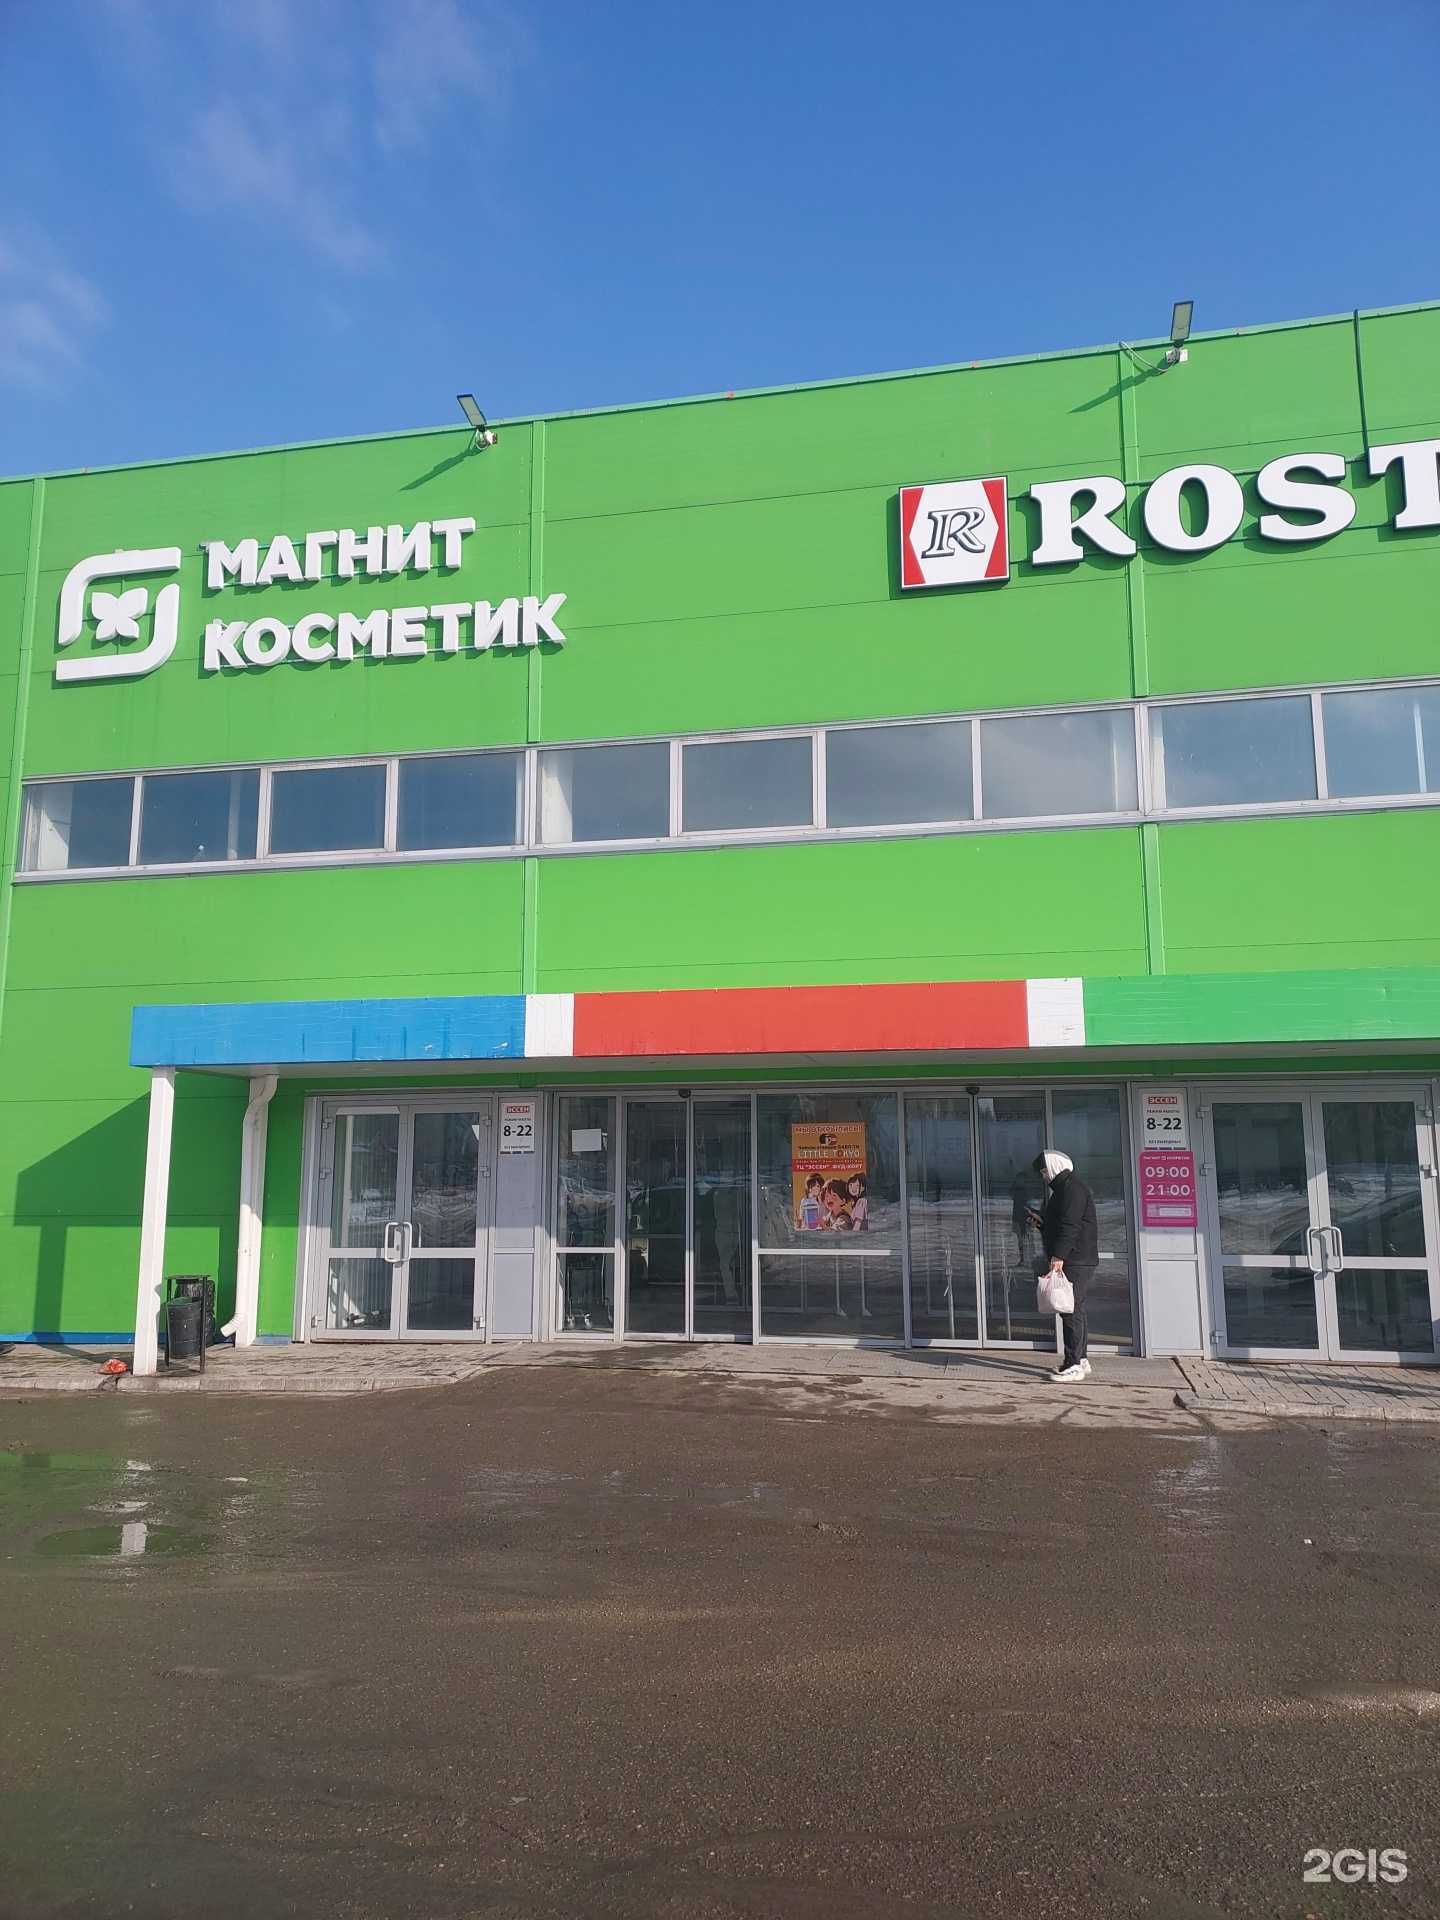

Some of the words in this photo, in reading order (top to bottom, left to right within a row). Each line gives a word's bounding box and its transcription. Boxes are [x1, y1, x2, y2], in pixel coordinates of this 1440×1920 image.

[205, 517, 476, 589] МАГНИТ
[203, 593, 567, 671] КОСМЕТИК
[1146, 1117, 1182, 1130] 8-22
[503, 1124, 532, 1137] 8-22
[798, 1150, 828, 1158] LITTLE
[833, 1149, 860, 1158] TOKYO
[1145, 1166, 1190, 1178] 09:00
[1146, 1184, 1191, 1196] 21:00
